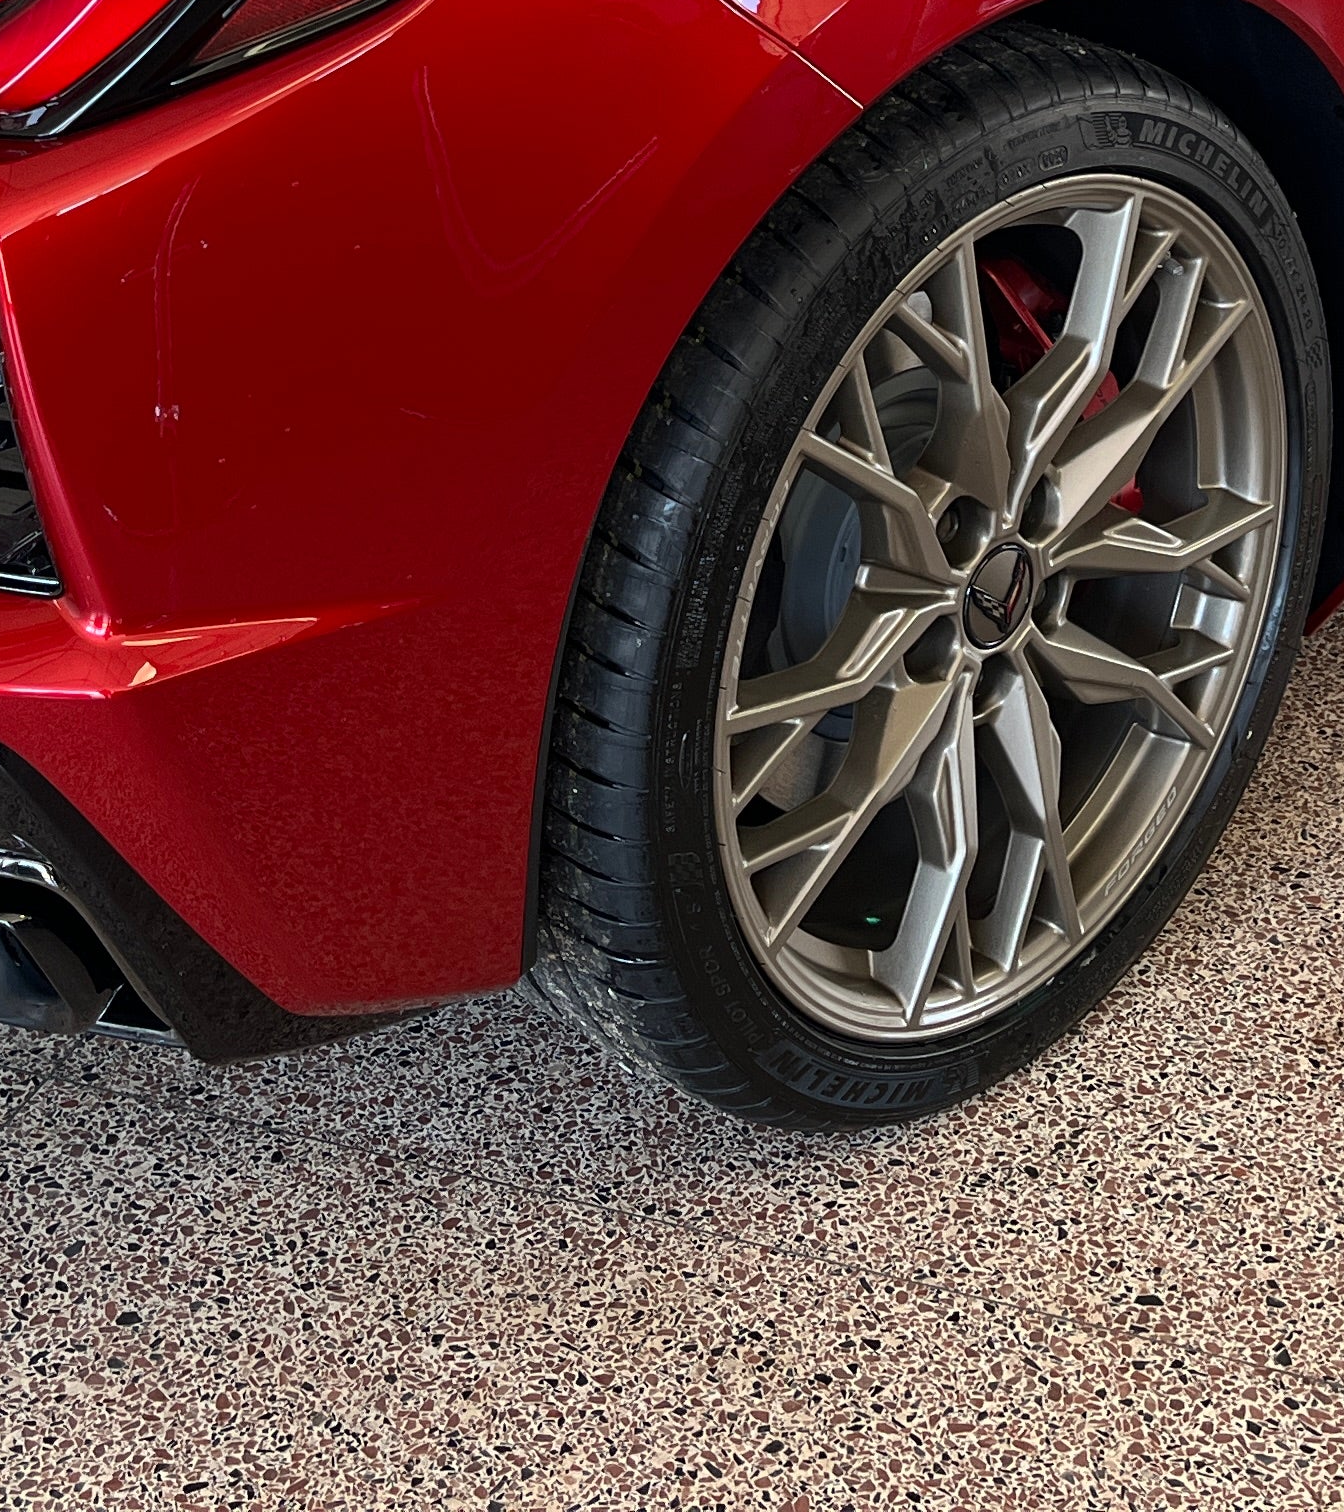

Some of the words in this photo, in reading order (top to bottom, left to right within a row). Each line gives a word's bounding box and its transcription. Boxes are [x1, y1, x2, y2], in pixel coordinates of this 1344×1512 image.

[1139, 118, 1269, 221] MICHELIN
[724, 999, 765, 1047] PILOT
[768, 1047, 937, 1106] MICHELIN
